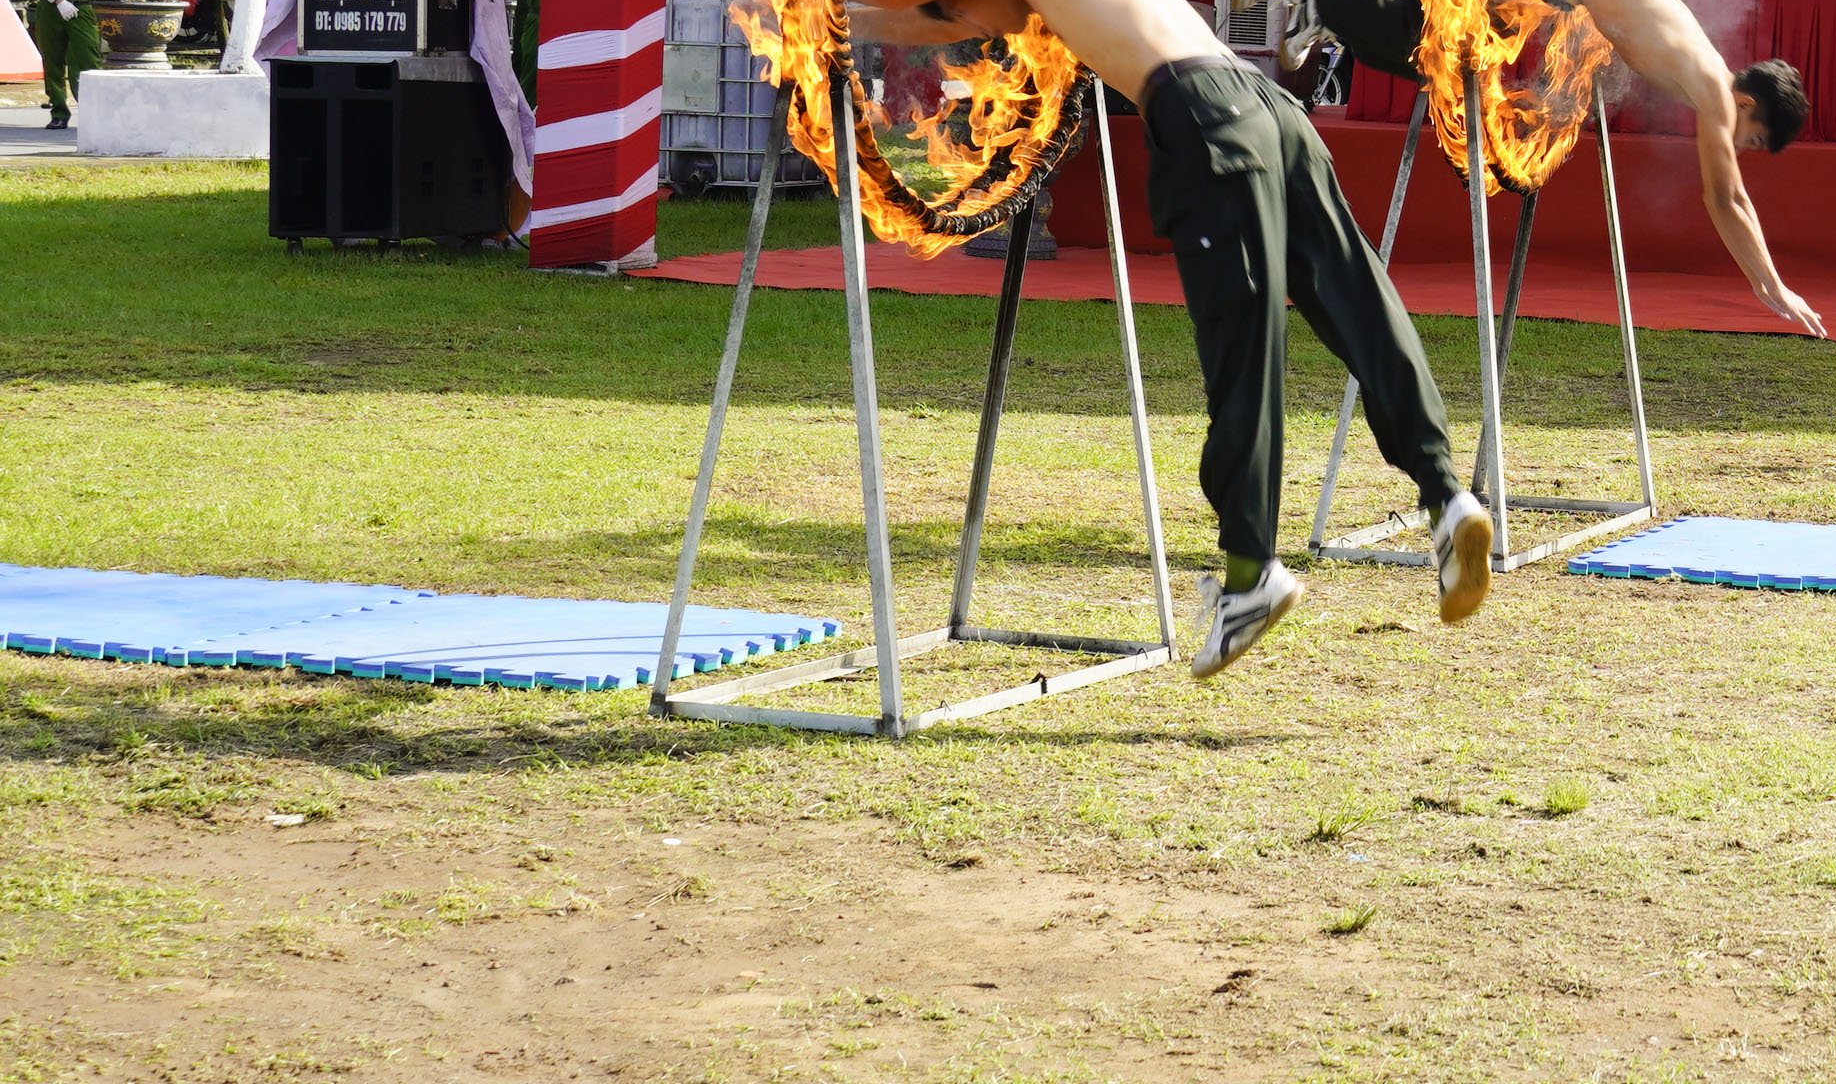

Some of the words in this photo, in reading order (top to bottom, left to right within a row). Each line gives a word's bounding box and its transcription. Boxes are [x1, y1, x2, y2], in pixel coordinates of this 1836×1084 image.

[315, 11, 331, 30] ĐT:
[334, 11, 361, 31] 0985
[364, 11, 384, 31] 179
[386, 12, 407, 31] 779
